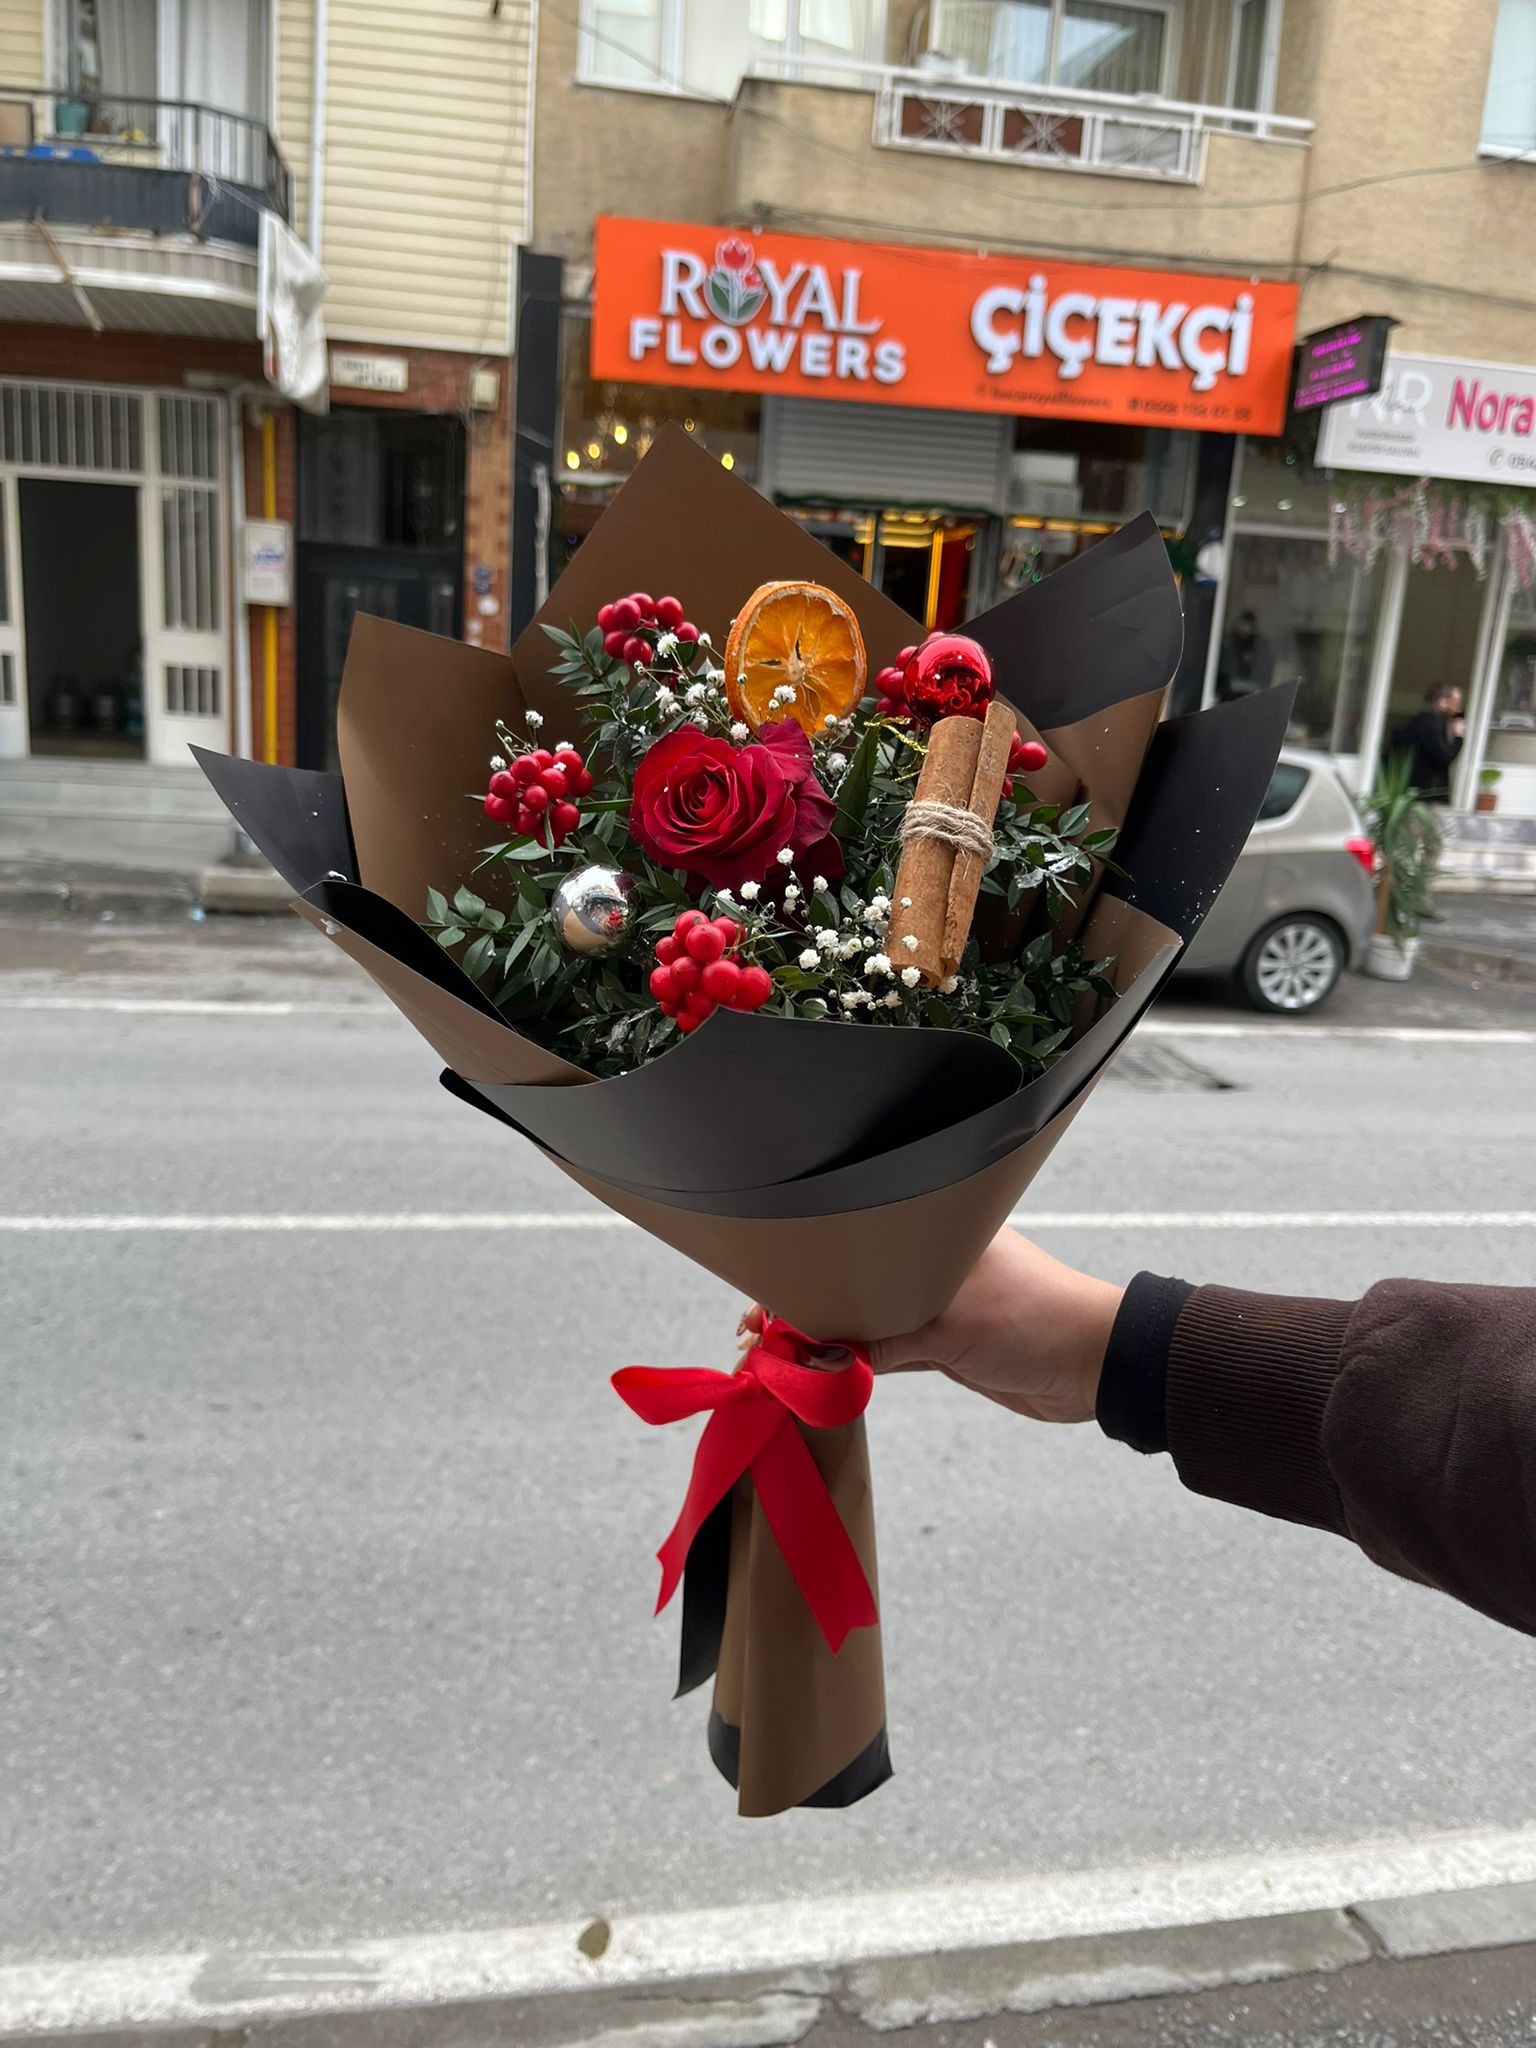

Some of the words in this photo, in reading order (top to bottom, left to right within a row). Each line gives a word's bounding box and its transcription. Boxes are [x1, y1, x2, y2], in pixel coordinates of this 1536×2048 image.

[629, 316, 906, 384] FLOWERS
[970, 273, 1254, 391] ÇİÇEKÇİ
[1446, 377, 1535, 437] Nora
